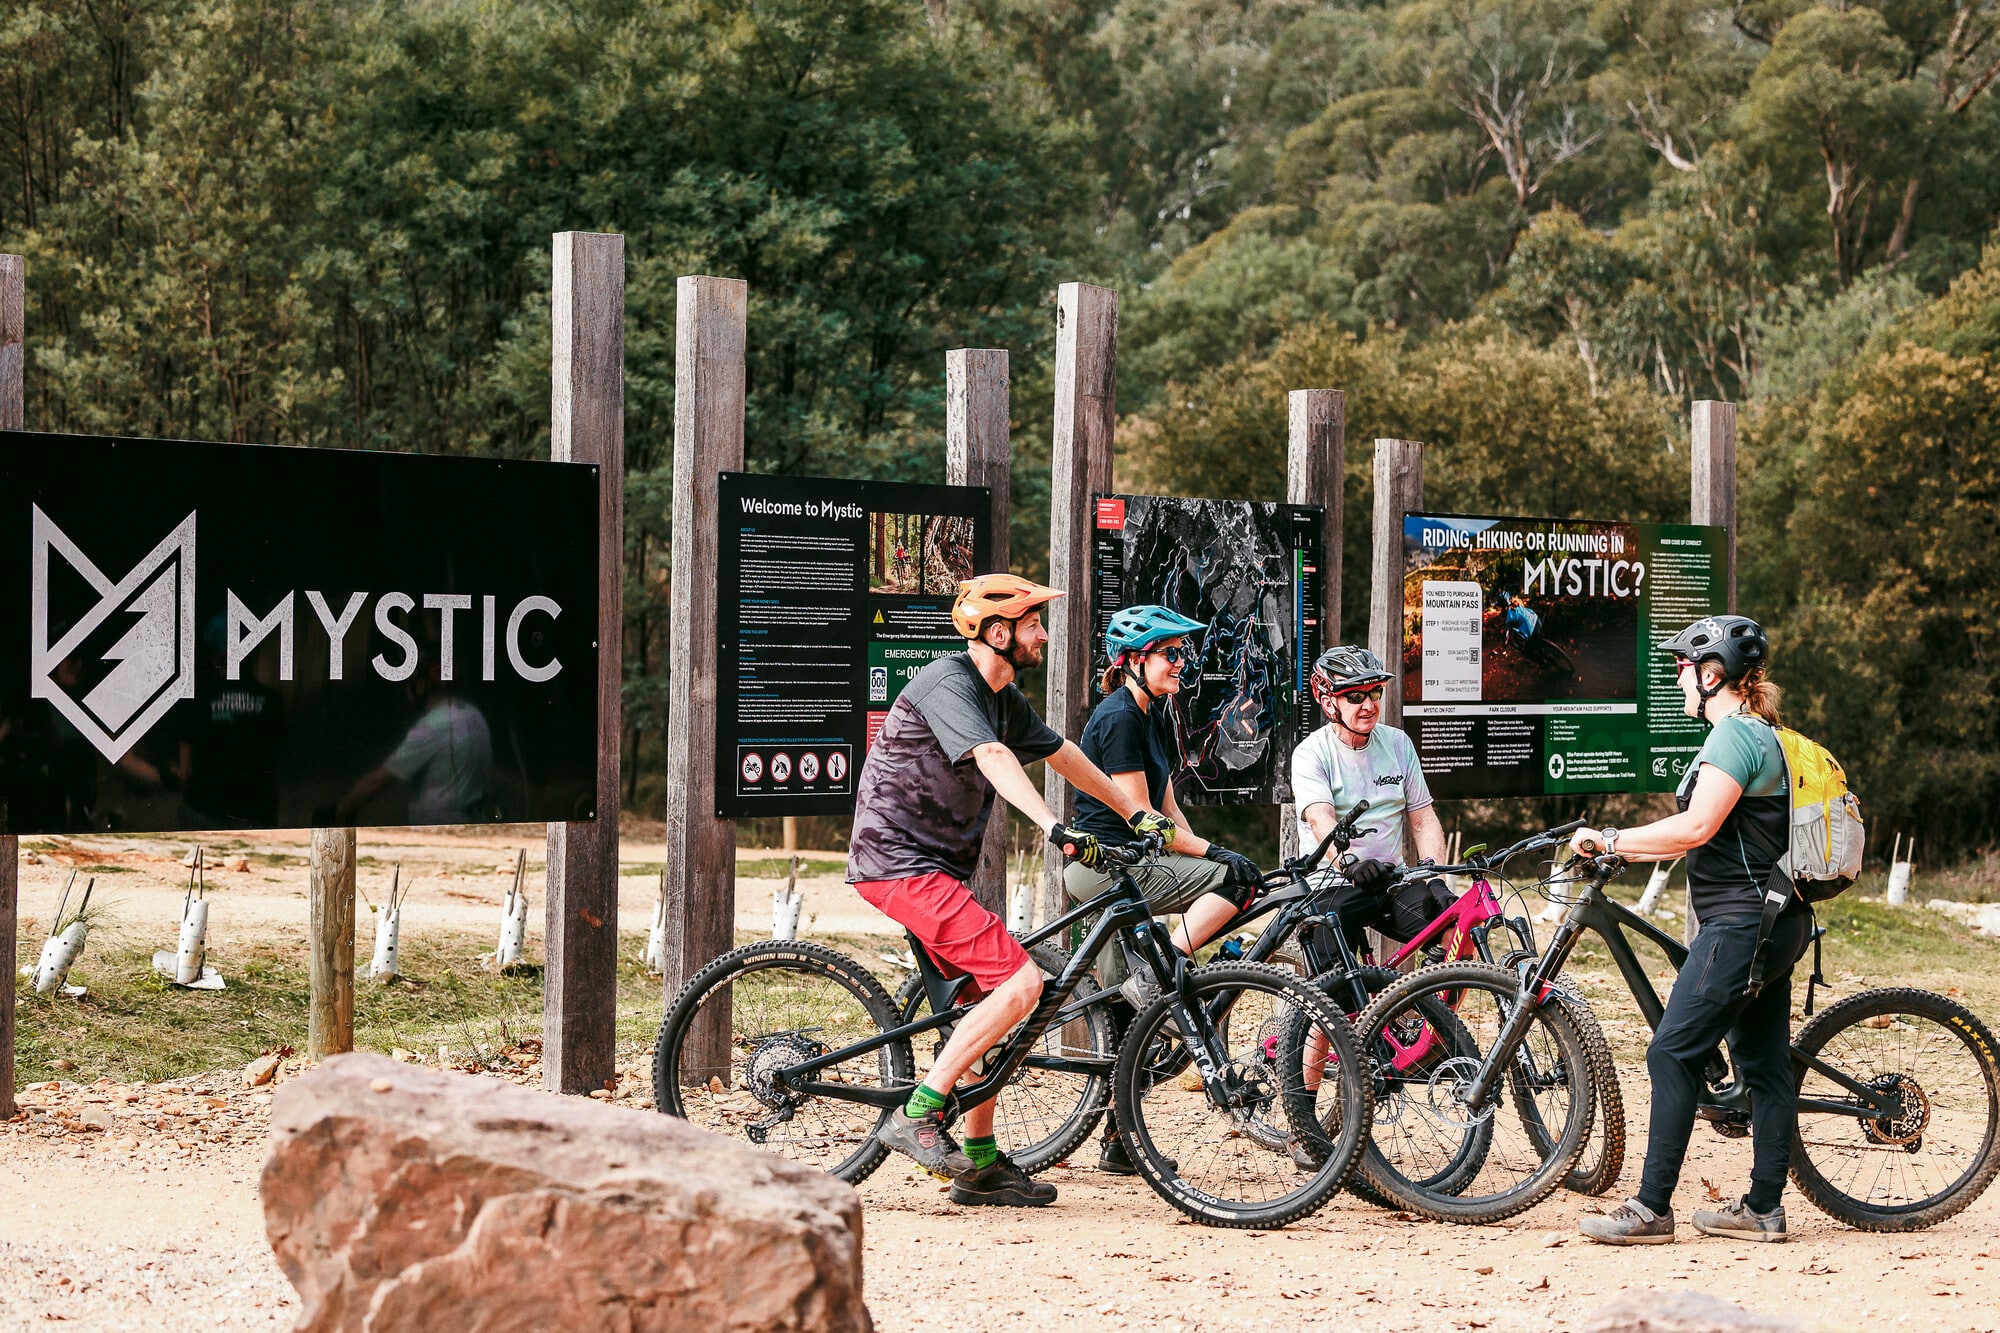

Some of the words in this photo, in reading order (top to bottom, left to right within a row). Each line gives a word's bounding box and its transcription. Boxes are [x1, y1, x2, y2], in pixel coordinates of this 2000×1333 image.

[741, 497, 802, 516] Welcome
[804, 501, 818, 516] to
[821, 500, 863, 521] Mystic
[1422, 528, 1473, 551] RIDING,
[1476, 530, 1523, 550] HIKING
[1526, 532, 1545, 550] OR
[1548, 533, 1607, 553] RUNNING
[1610, 536, 1624, 554] IN
[1524, 557, 1645, 598] MYSTIC?
[1426, 600, 1460, 608] MOUNTAIN
[1462, 600, 1479, 609] PASS
[227, 588, 562, 682] MYSTIC
[1702, 618, 1722, 637] POC
[885, 649, 930, 658] EMERGENCY
[872, 677, 886, 687] 000
[907, 666, 926, 680] 00
[1081, 929, 1086, 938] 5
[1446, 926, 1463, 964] RUZ
[742, 953, 776, 965] MINION
[1278, 991, 1304, 1009] SWISS
[1282, 986, 1335, 1030] MAXXIS
[1360, 1016, 1378, 1042] TCHER
[1951, 1016, 1995, 1062] MAXXIS
[1193, 1045, 1219, 1084] FOX
[1194, 1190, 1217, 1205] 1700
